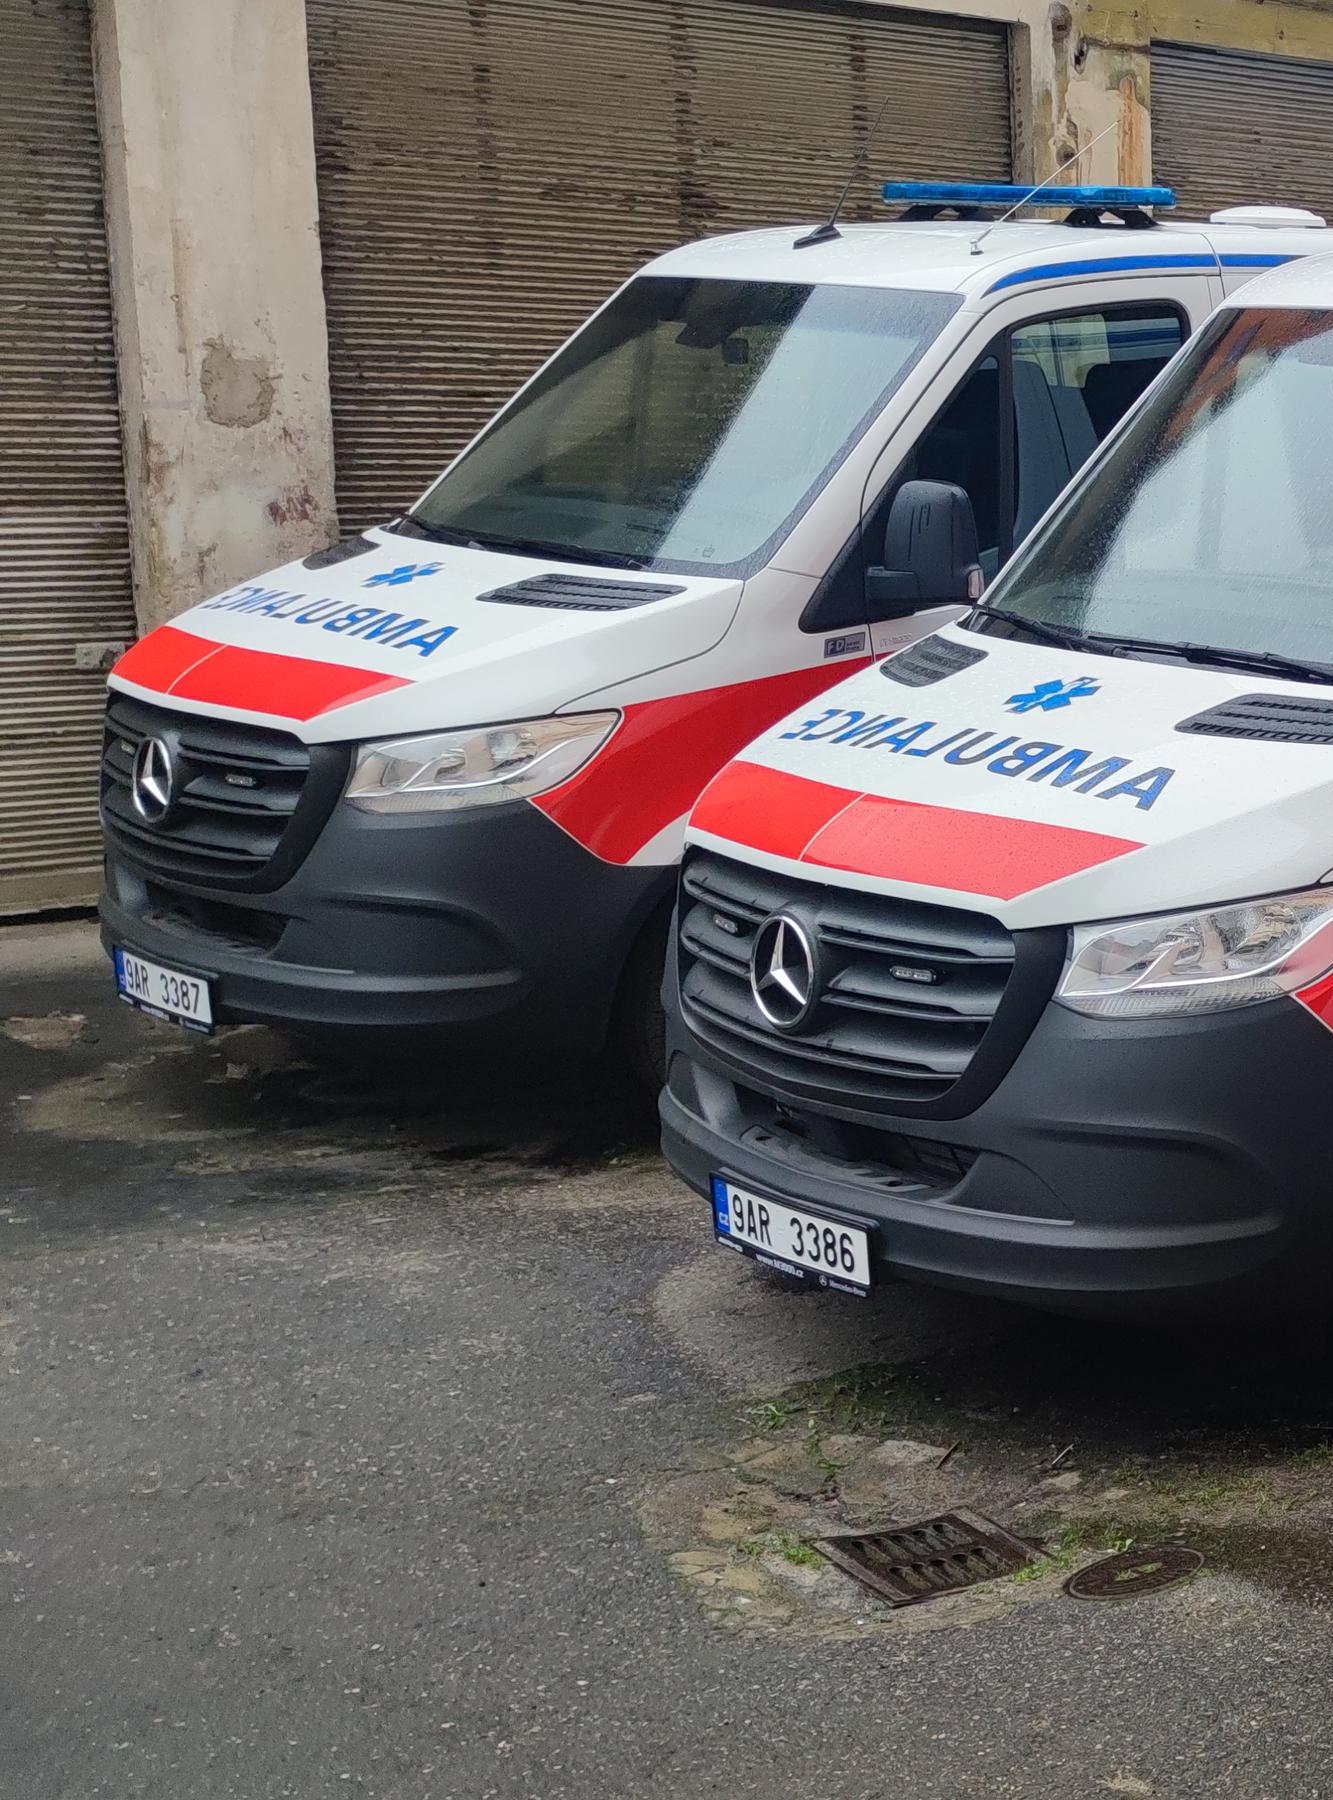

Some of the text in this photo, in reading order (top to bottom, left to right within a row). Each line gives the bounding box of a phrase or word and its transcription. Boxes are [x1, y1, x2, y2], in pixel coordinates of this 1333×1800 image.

[126, 958, 151, 998] 9AR
[160, 973, 200, 1014] 3387
[732, 1193, 856, 1274] 9AR 3386
